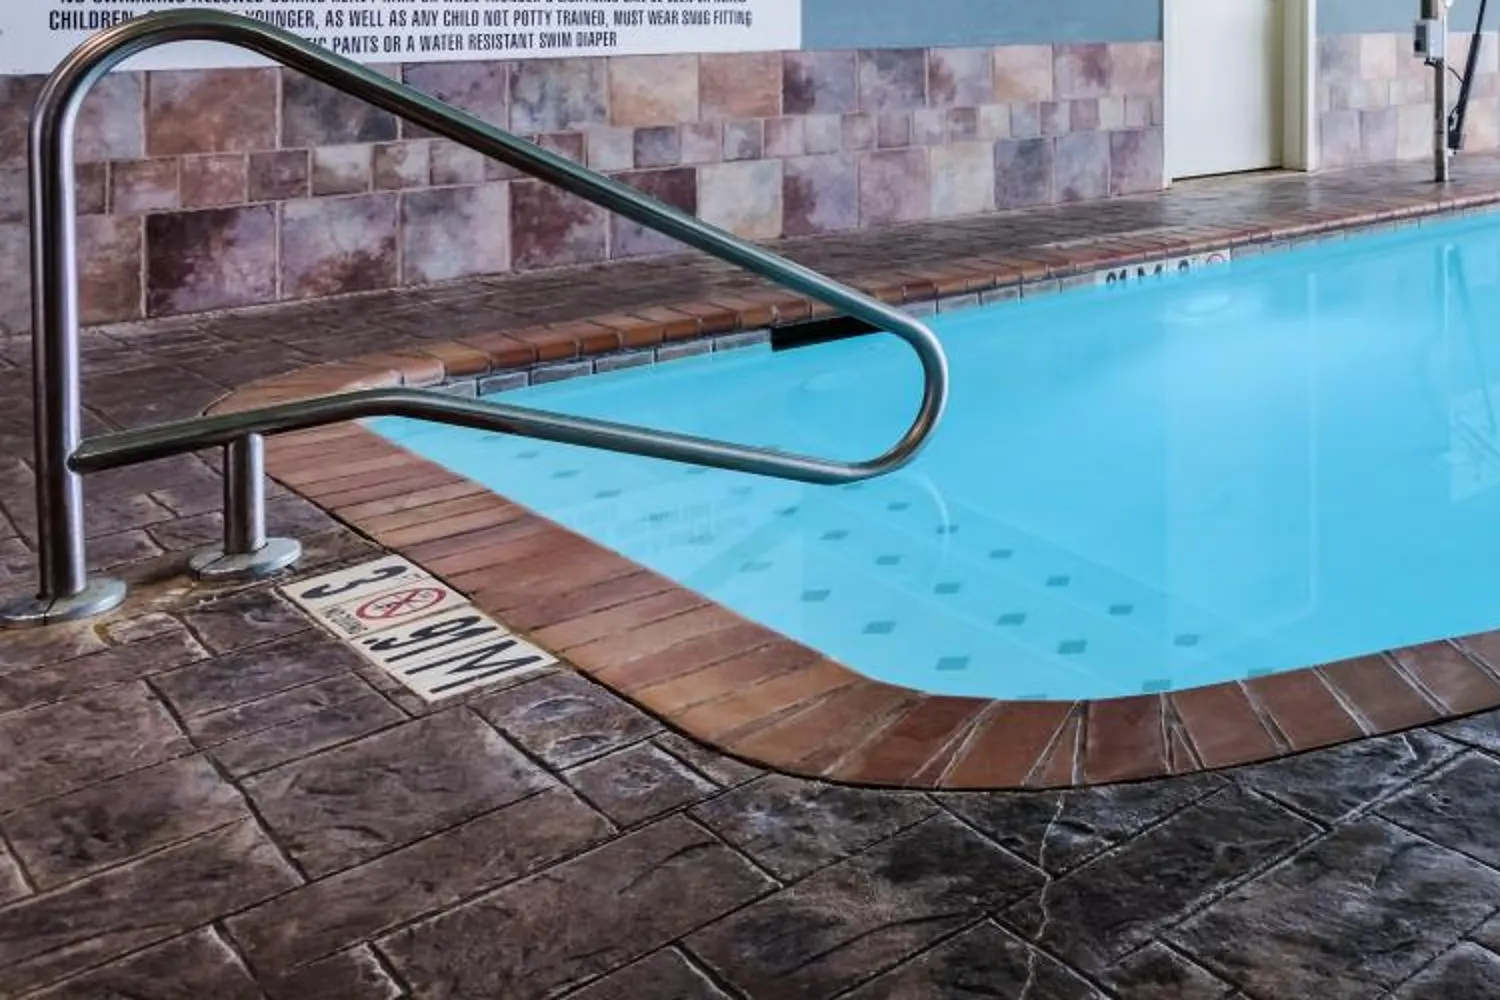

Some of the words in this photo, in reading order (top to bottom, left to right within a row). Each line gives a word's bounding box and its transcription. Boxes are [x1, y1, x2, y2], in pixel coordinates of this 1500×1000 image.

[325, 10, 343, 27] AS
[350, 10, 384, 27] WELL
[389, 10, 407, 27] AS
[411, 10, 438, 27] ANY
[443, 10, 479, 26] CHILD
[484, 10, 509, 26] NOT
[514, 11, 551, 26] POTTY
[557, 11, 609, 28] TRAINED,
[614, 10, 644, 25] MUST
[648, 10, 679, 25] WEAR
[682, 11, 711, 25] SNUG
[714, 10, 752, 27] FITTING
[333, 36, 379, 53] PANTS
[384, 36, 400, 52] OR
[407, 37, 415, 51] A
[419, 35, 464, 51] WATER
[468, 33, 534, 51] RESISTANT
[539, 32, 572, 48] SWIM
[576, 31, 617, 47] DIAPER
[301, 565, 408, 599] 3
